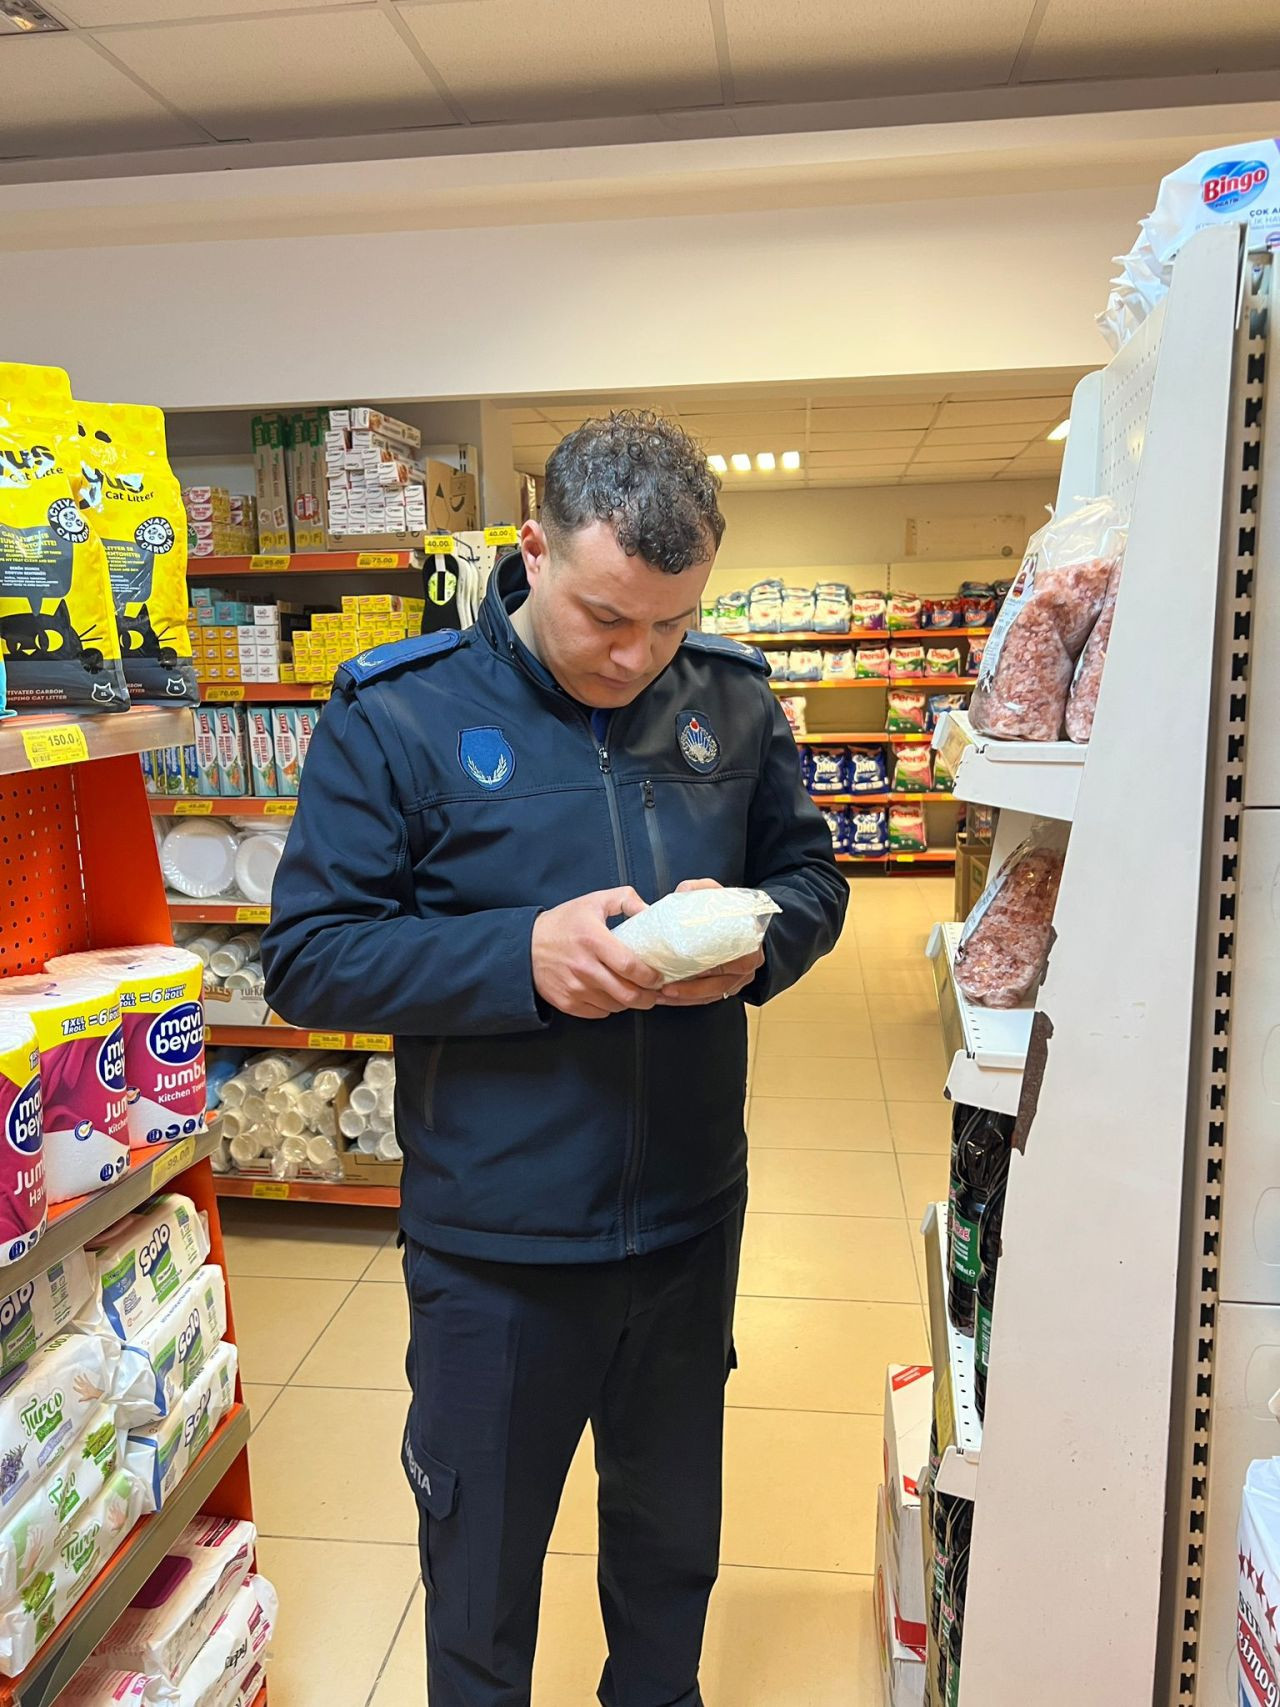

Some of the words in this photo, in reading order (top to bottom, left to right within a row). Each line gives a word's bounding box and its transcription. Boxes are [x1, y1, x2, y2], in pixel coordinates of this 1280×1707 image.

[1203, 168, 1266, 203] Bingo
[105, 490, 124, 500] Cat
[127, 491, 154, 502] Litter
[136, 517, 173, 541] ACTIVATED
[141, 538, 173, 553] CARBON
[164, 989, 184, 1001] ROLL
[160, 1006, 200, 1037] mavi
[155, 1025, 203, 1055] beyaz
[158, 1089, 190, 1104] Kitchen
[139, 1223, 171, 1278] Solo
[178, 1307, 201, 1364] Solo
[20, 1391, 63, 1437] Turco
